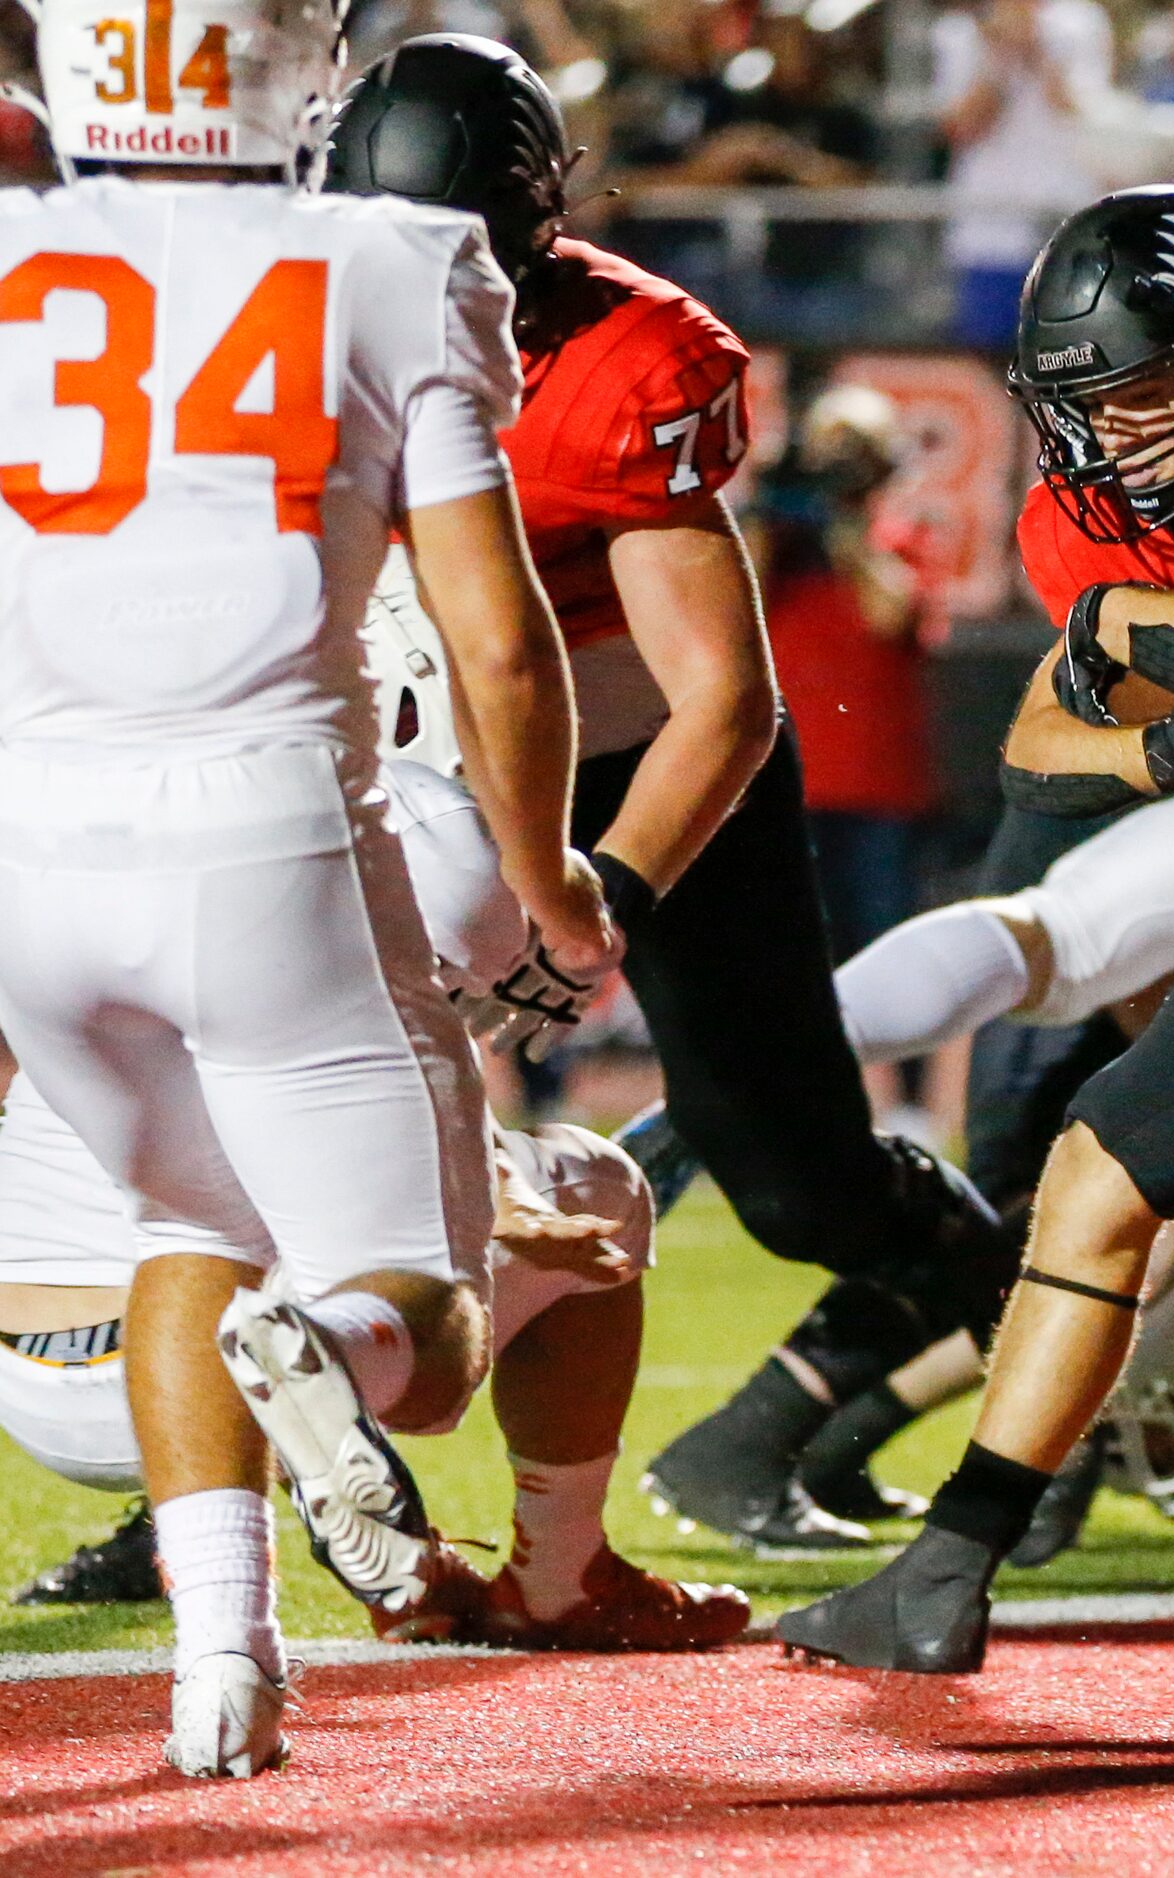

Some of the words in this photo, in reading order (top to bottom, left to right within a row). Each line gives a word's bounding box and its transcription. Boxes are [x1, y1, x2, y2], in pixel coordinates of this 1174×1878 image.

[94, 18, 231, 109] 34
[86, 124, 230, 156] Riddell
[0, 250, 340, 540] 34
[1037, 347, 1094, 372] ARGYLE
[653, 377, 745, 495] 77
